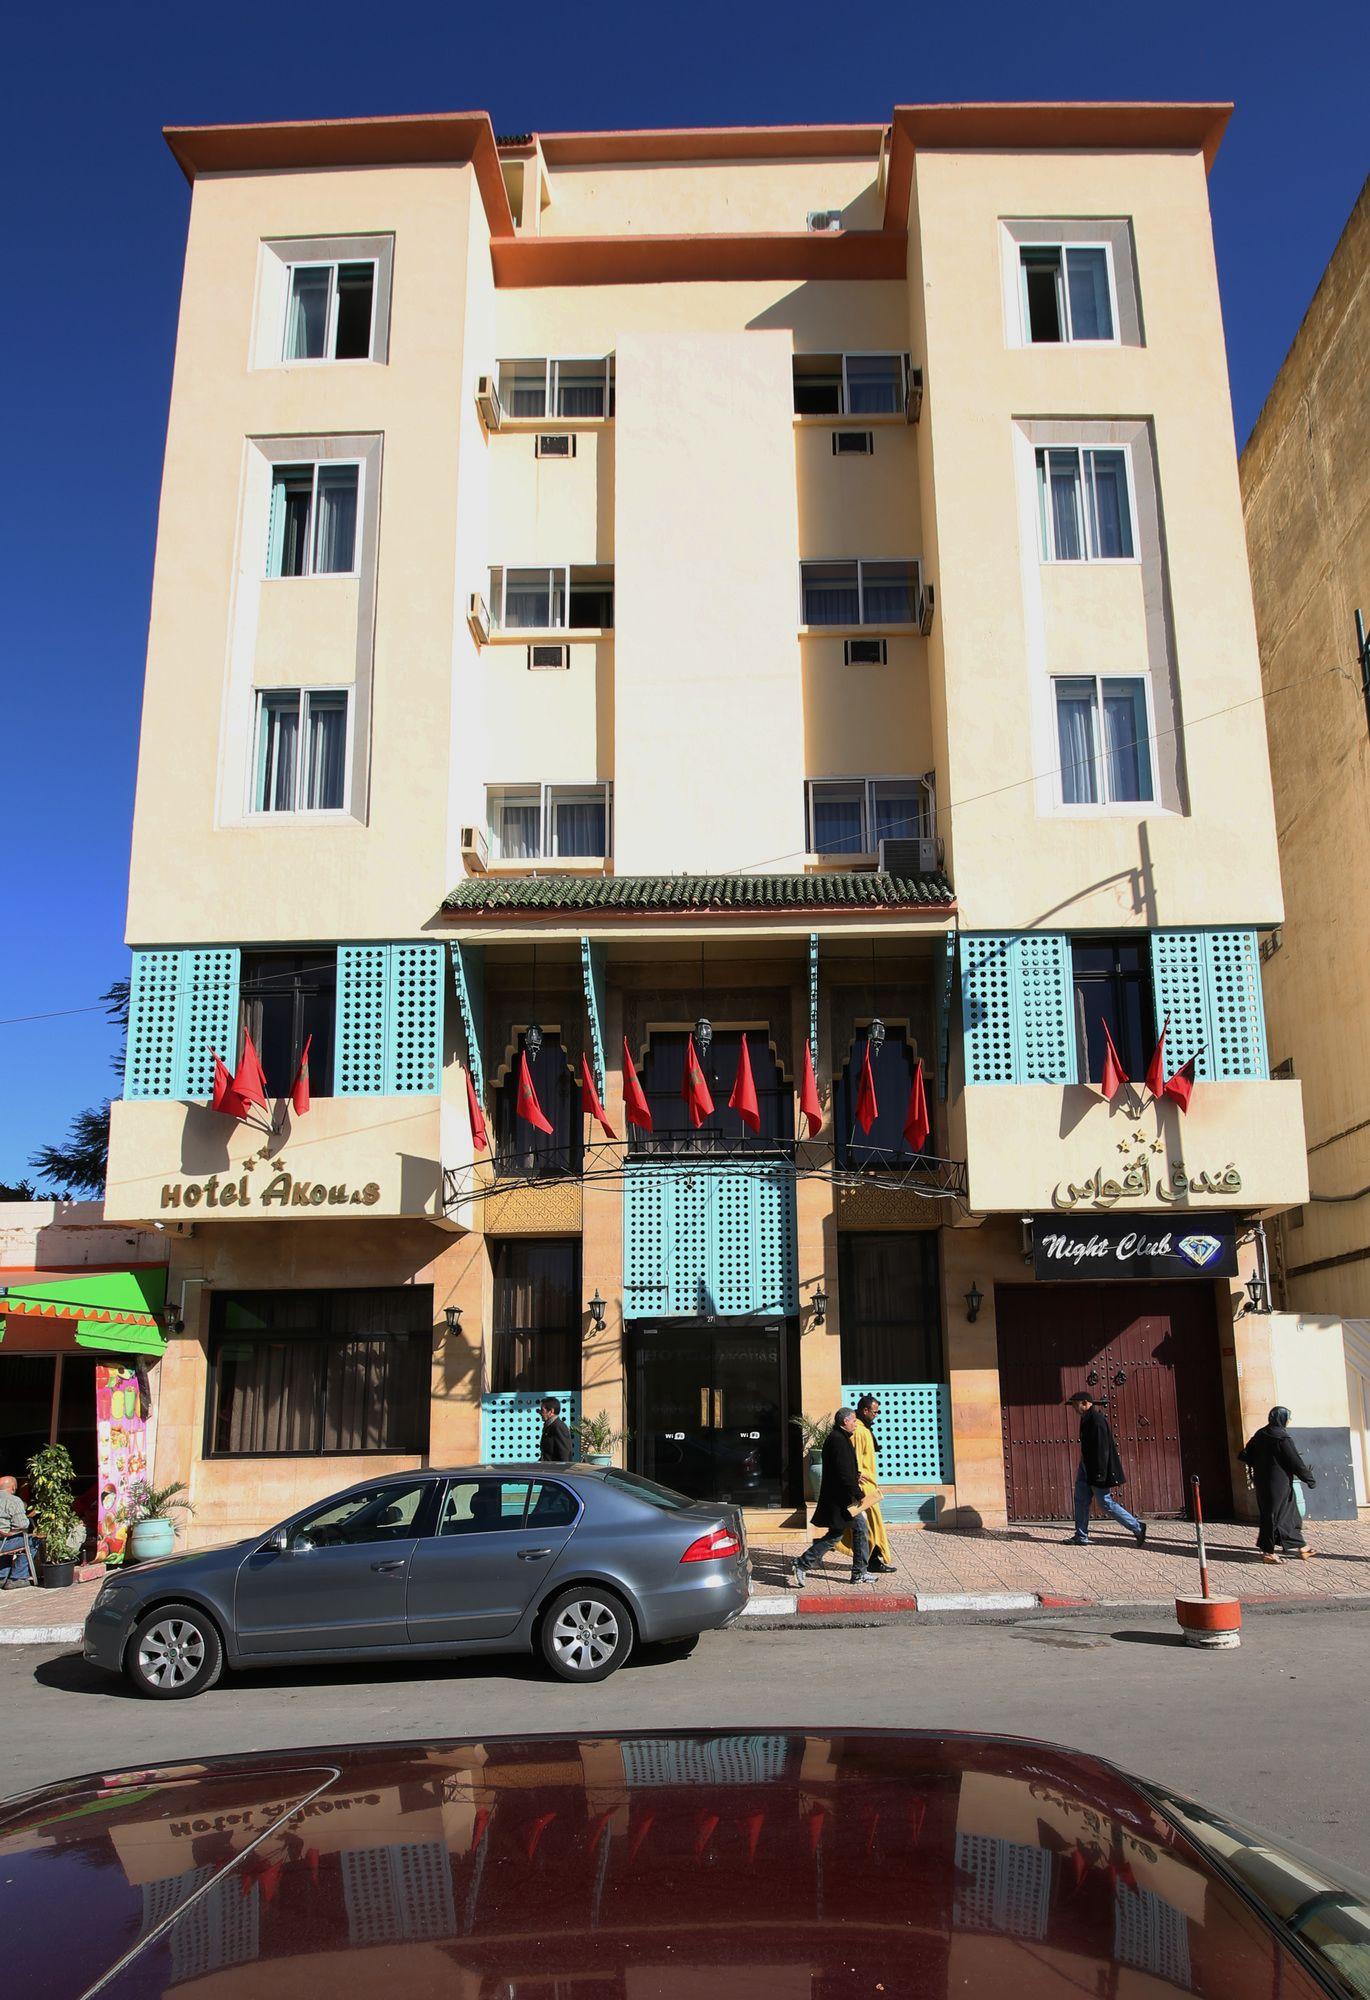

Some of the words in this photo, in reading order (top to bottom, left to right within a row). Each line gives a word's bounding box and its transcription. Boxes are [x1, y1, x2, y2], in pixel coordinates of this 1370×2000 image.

[1156, 1161, 1243, 1203] فندق
[1042, 1233, 1109, 1265] Night
[1116, 1232, 1172, 1261] Club
